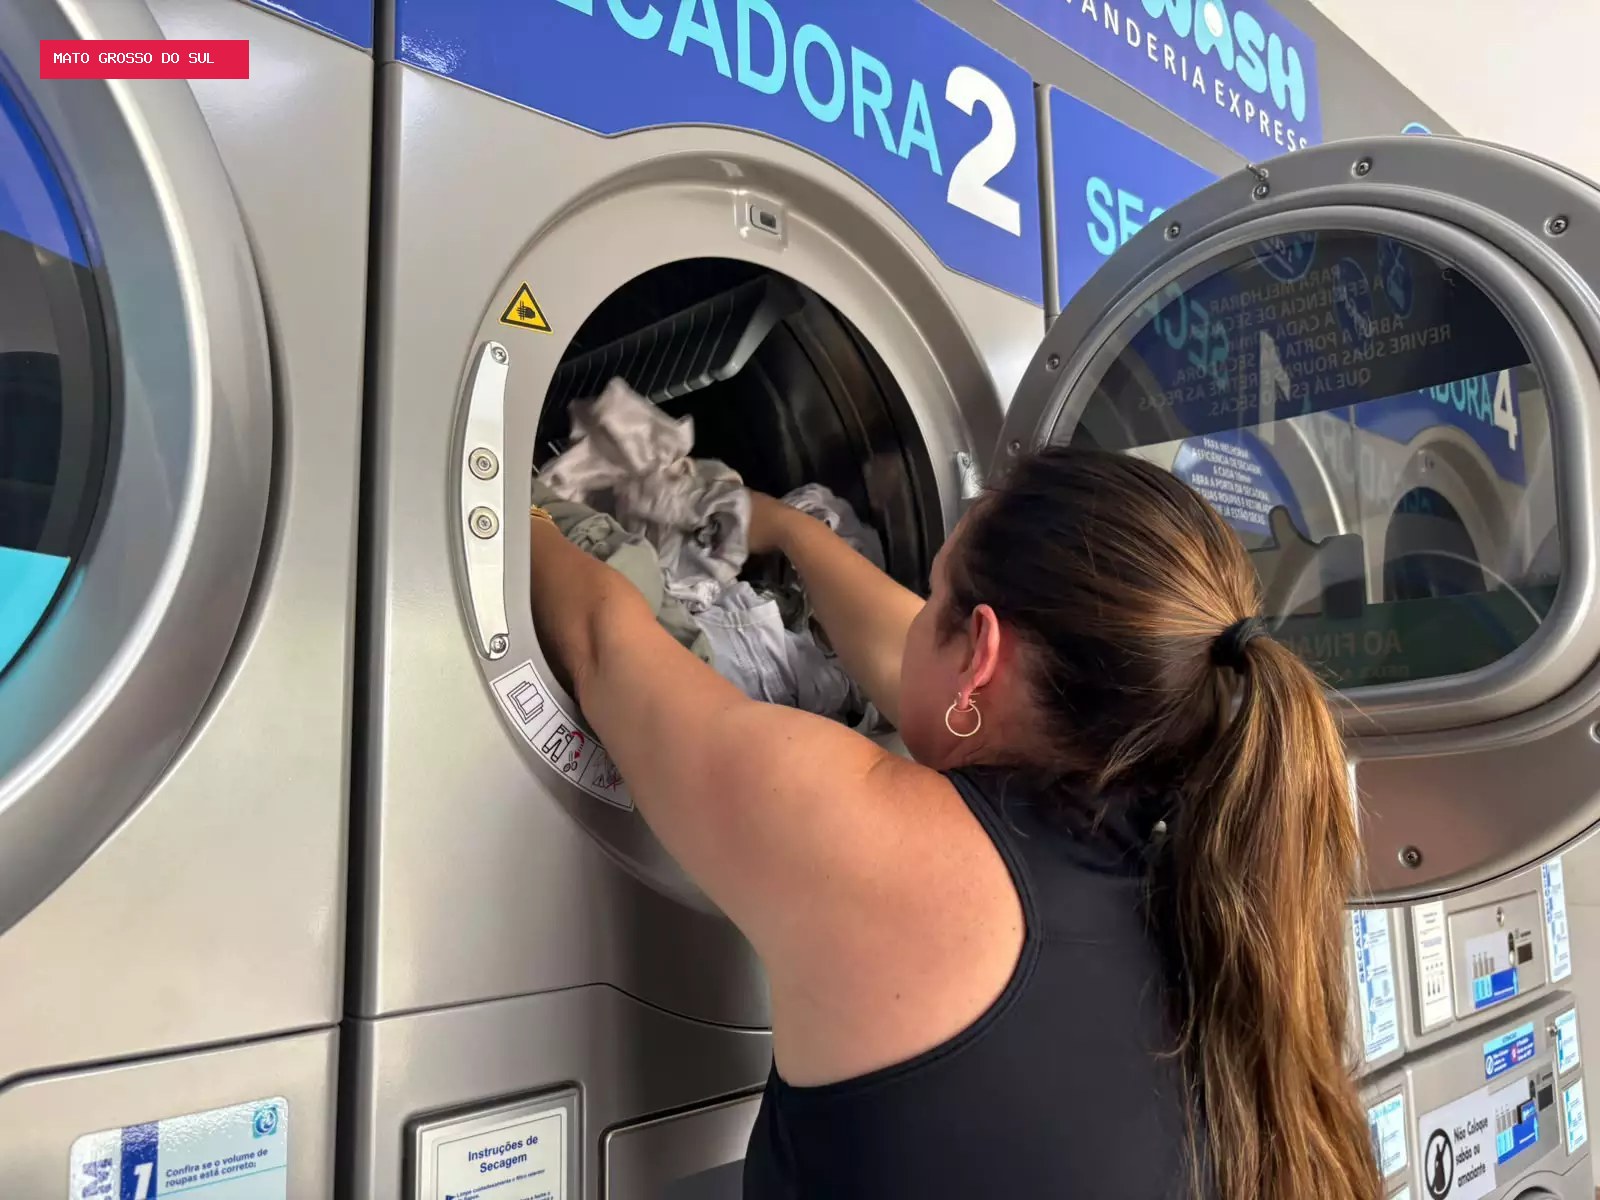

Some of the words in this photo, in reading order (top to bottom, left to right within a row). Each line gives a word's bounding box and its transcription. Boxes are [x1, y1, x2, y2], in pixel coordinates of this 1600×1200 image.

[1066, 0, 1205, 94] ANDERIA
[555, 0, 943, 176] ADORA
[945, 65, 1021, 237] 2
[1086, 176, 1165, 256] SE
[1418, 374, 1494, 427] DORA
[1493, 369, 1518, 451] 4
[1353, 909, 1366, 984] SECAGE
[1467, 1116, 1489, 1137] Coloque
[165, 1163, 200, 1178] Confira
[202, 1162, 213, 1170] se
[214, 1159, 220, 1167] o
[222, 1152, 256, 1165] volume
[257, 1148, 269, 1157] de
[468, 1140, 523, 1162] Instruções
[526, 1135, 539, 1146] de
[480, 1153, 527, 1174] Secagem
[1473, 1143, 1481, 1154] ou
[165, 1174, 198, 1188] roupas
[199, 1168, 219, 1180] está
